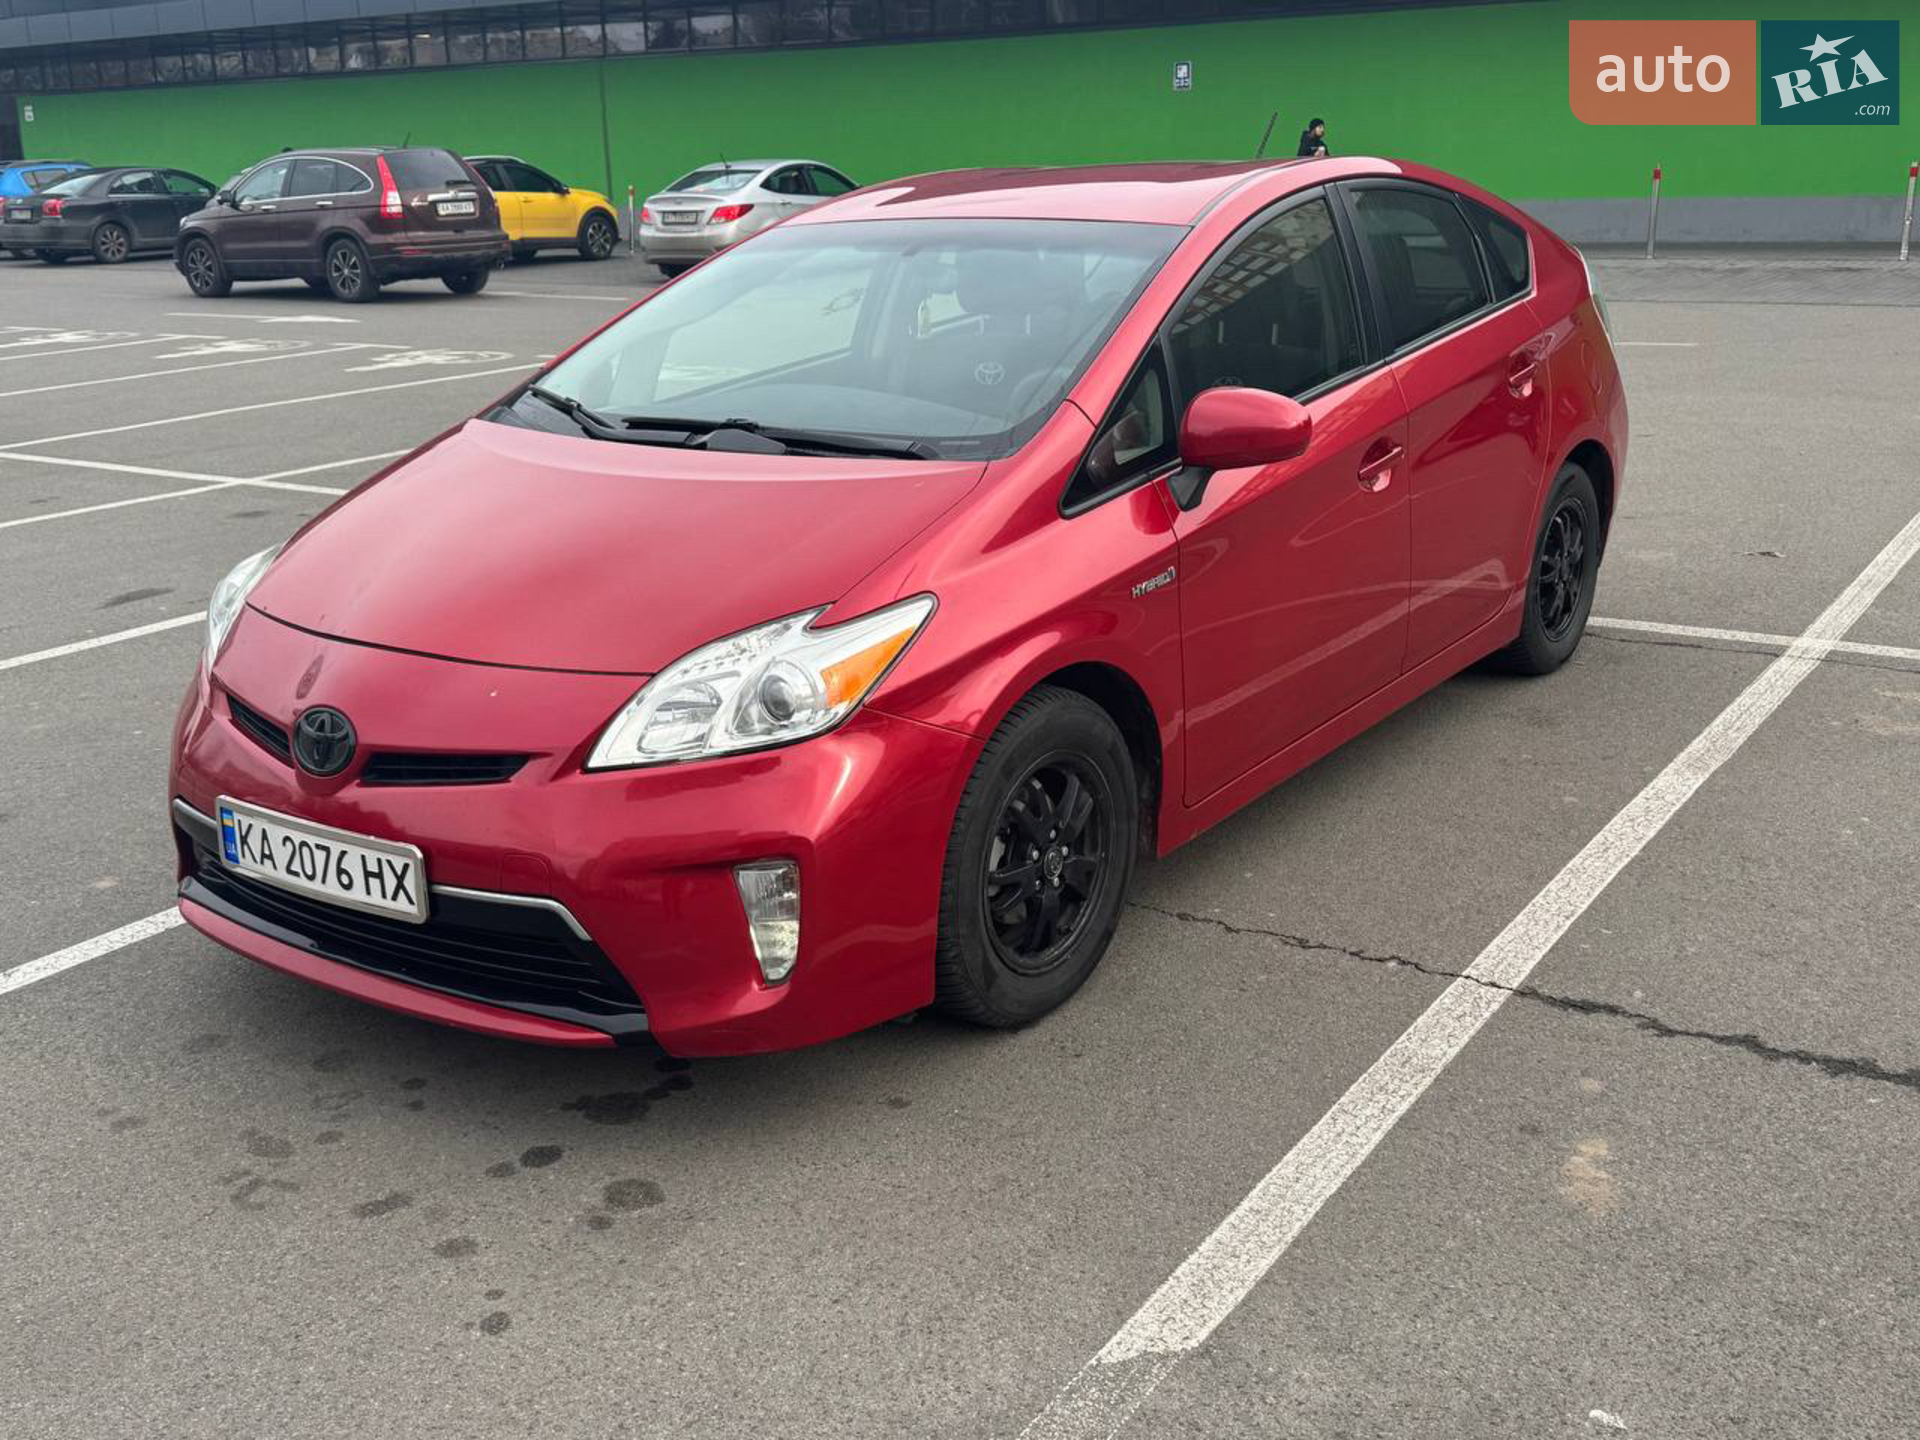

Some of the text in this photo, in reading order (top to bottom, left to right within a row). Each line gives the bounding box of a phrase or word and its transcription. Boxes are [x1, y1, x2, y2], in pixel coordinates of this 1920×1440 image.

[237, 818, 416, 906] KA 2076 HX
